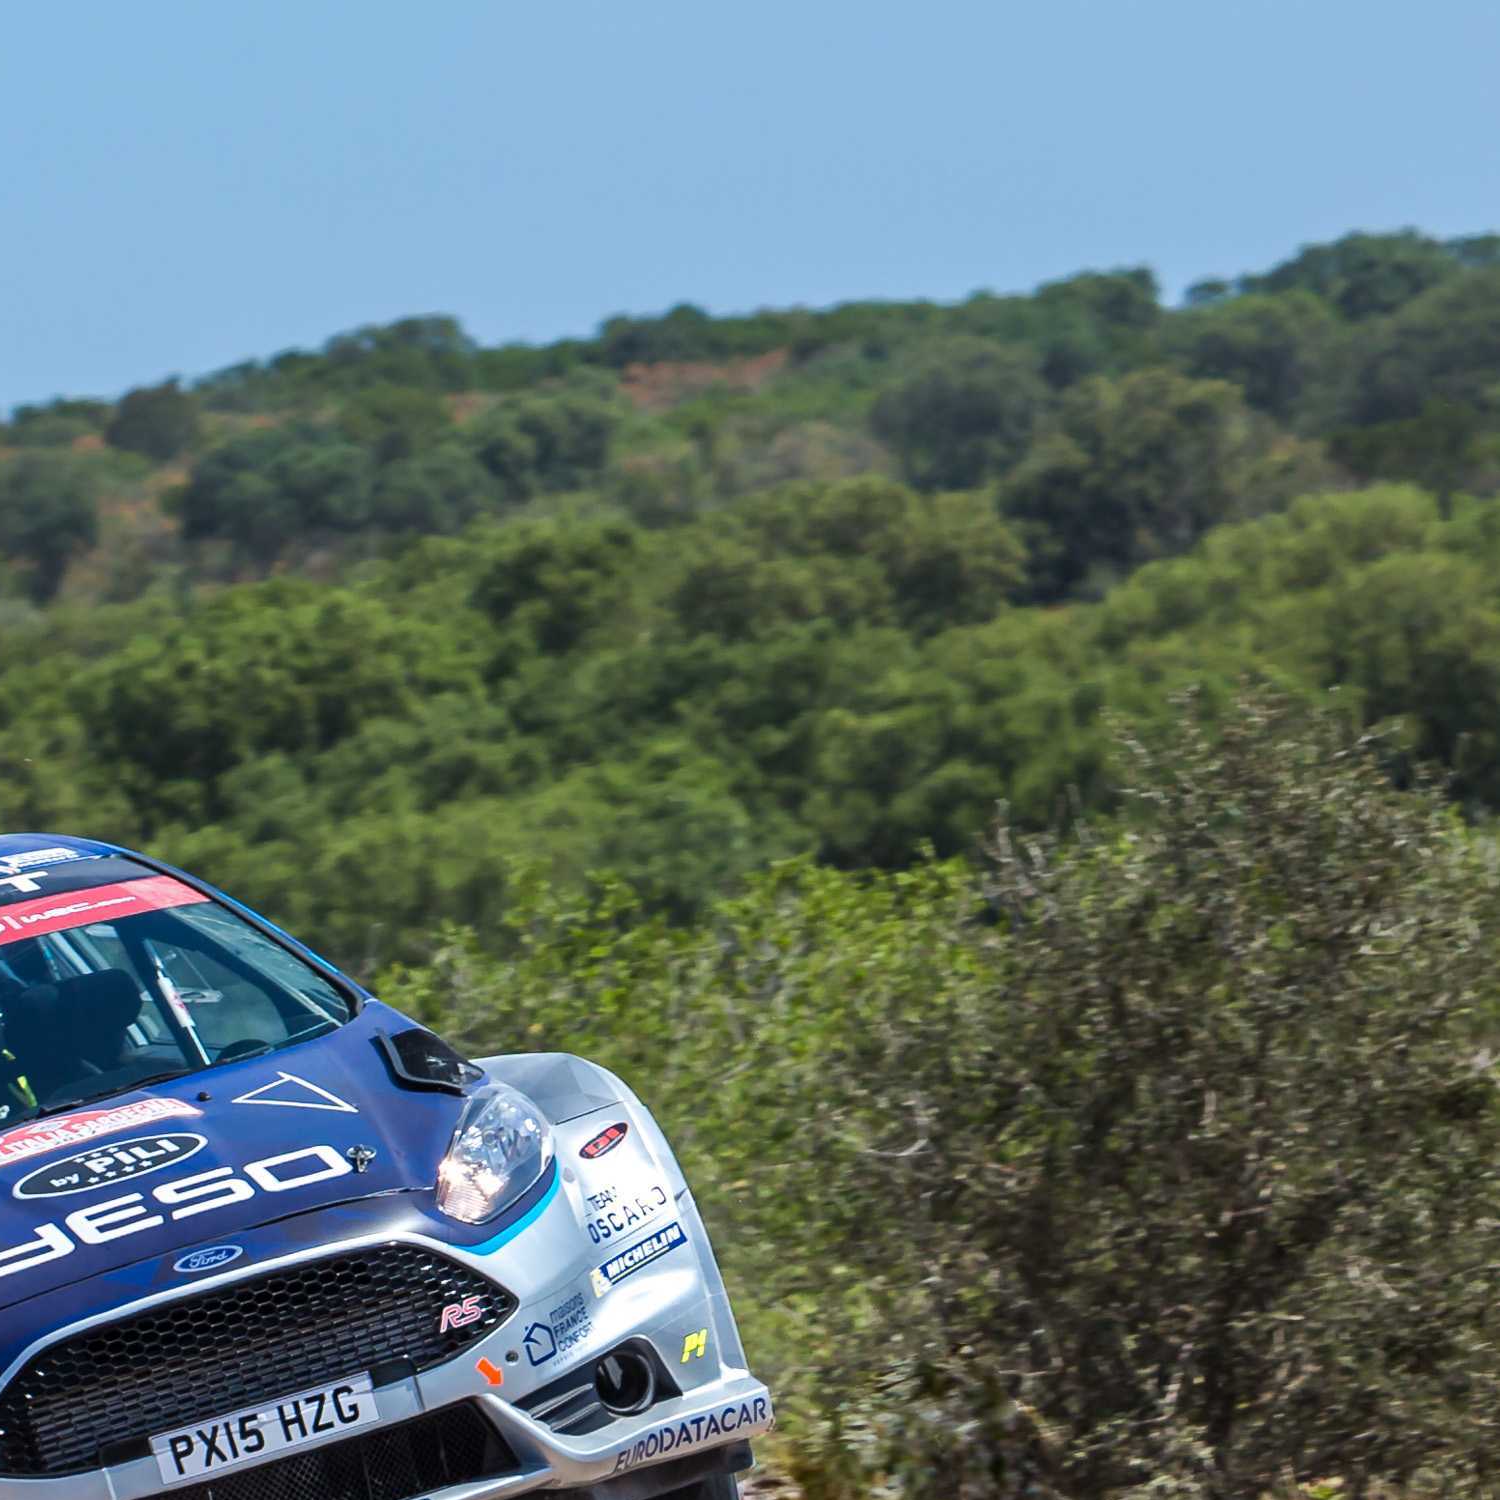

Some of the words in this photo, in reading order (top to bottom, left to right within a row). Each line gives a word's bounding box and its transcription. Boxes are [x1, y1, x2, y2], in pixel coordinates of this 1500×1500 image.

[3, 1127, 71, 1156] ITALIA
[70, 1099, 179, 1134] SARDEGNA
[50, 1172, 80, 1188] by
[84, 1138, 181, 1174] PILI
[606, 1224, 682, 1278] MICHELIN
[553, 1306, 589, 1338] FRANCE
[169, 1413, 265, 1476] PX15
[277, 1385, 360, 1442] HZG
[613, 1397, 767, 1474] EURODATACAR
